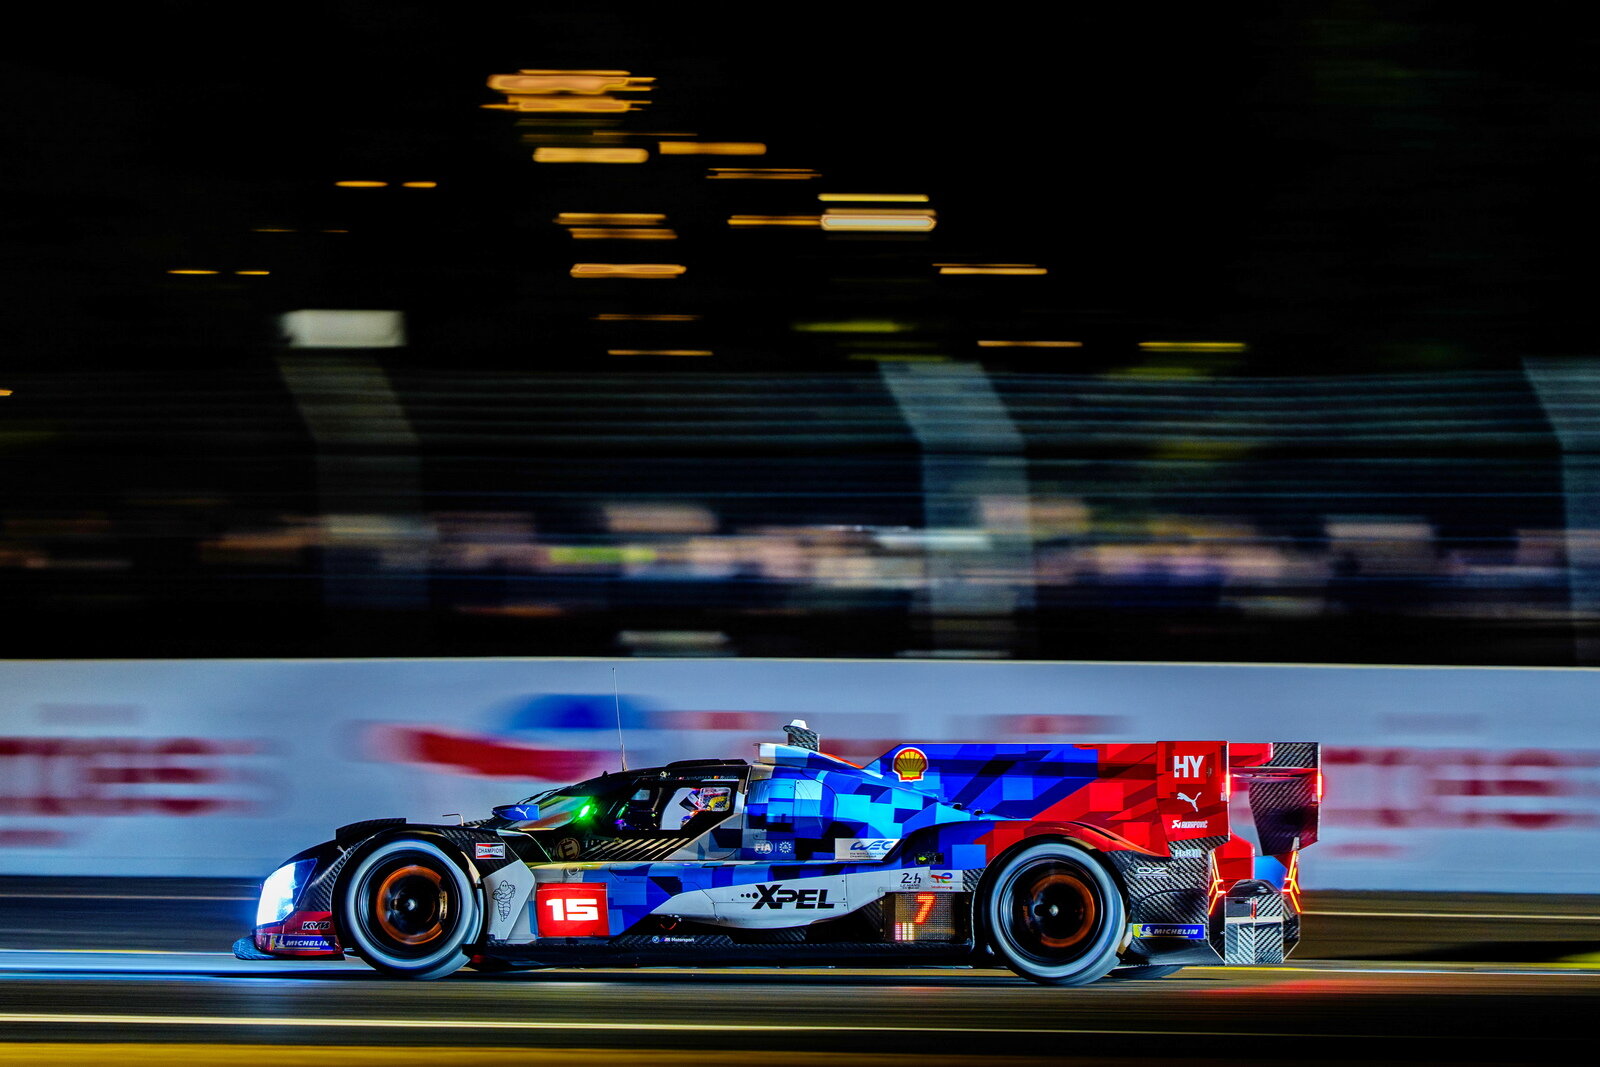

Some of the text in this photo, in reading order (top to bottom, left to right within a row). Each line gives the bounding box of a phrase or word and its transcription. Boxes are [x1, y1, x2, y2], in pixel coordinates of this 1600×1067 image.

[1173, 755, 1204, 778] HY
[477, 845, 503, 854] CHAMPION
[754, 842, 772, 852] FIA
[1137, 866, 1168, 874] OZ
[752, 884, 835, 909] XPEL
[546, 898, 599, 921] 15
[914, 892, 937, 925] 7
[302, 921, 331, 930] KYB
